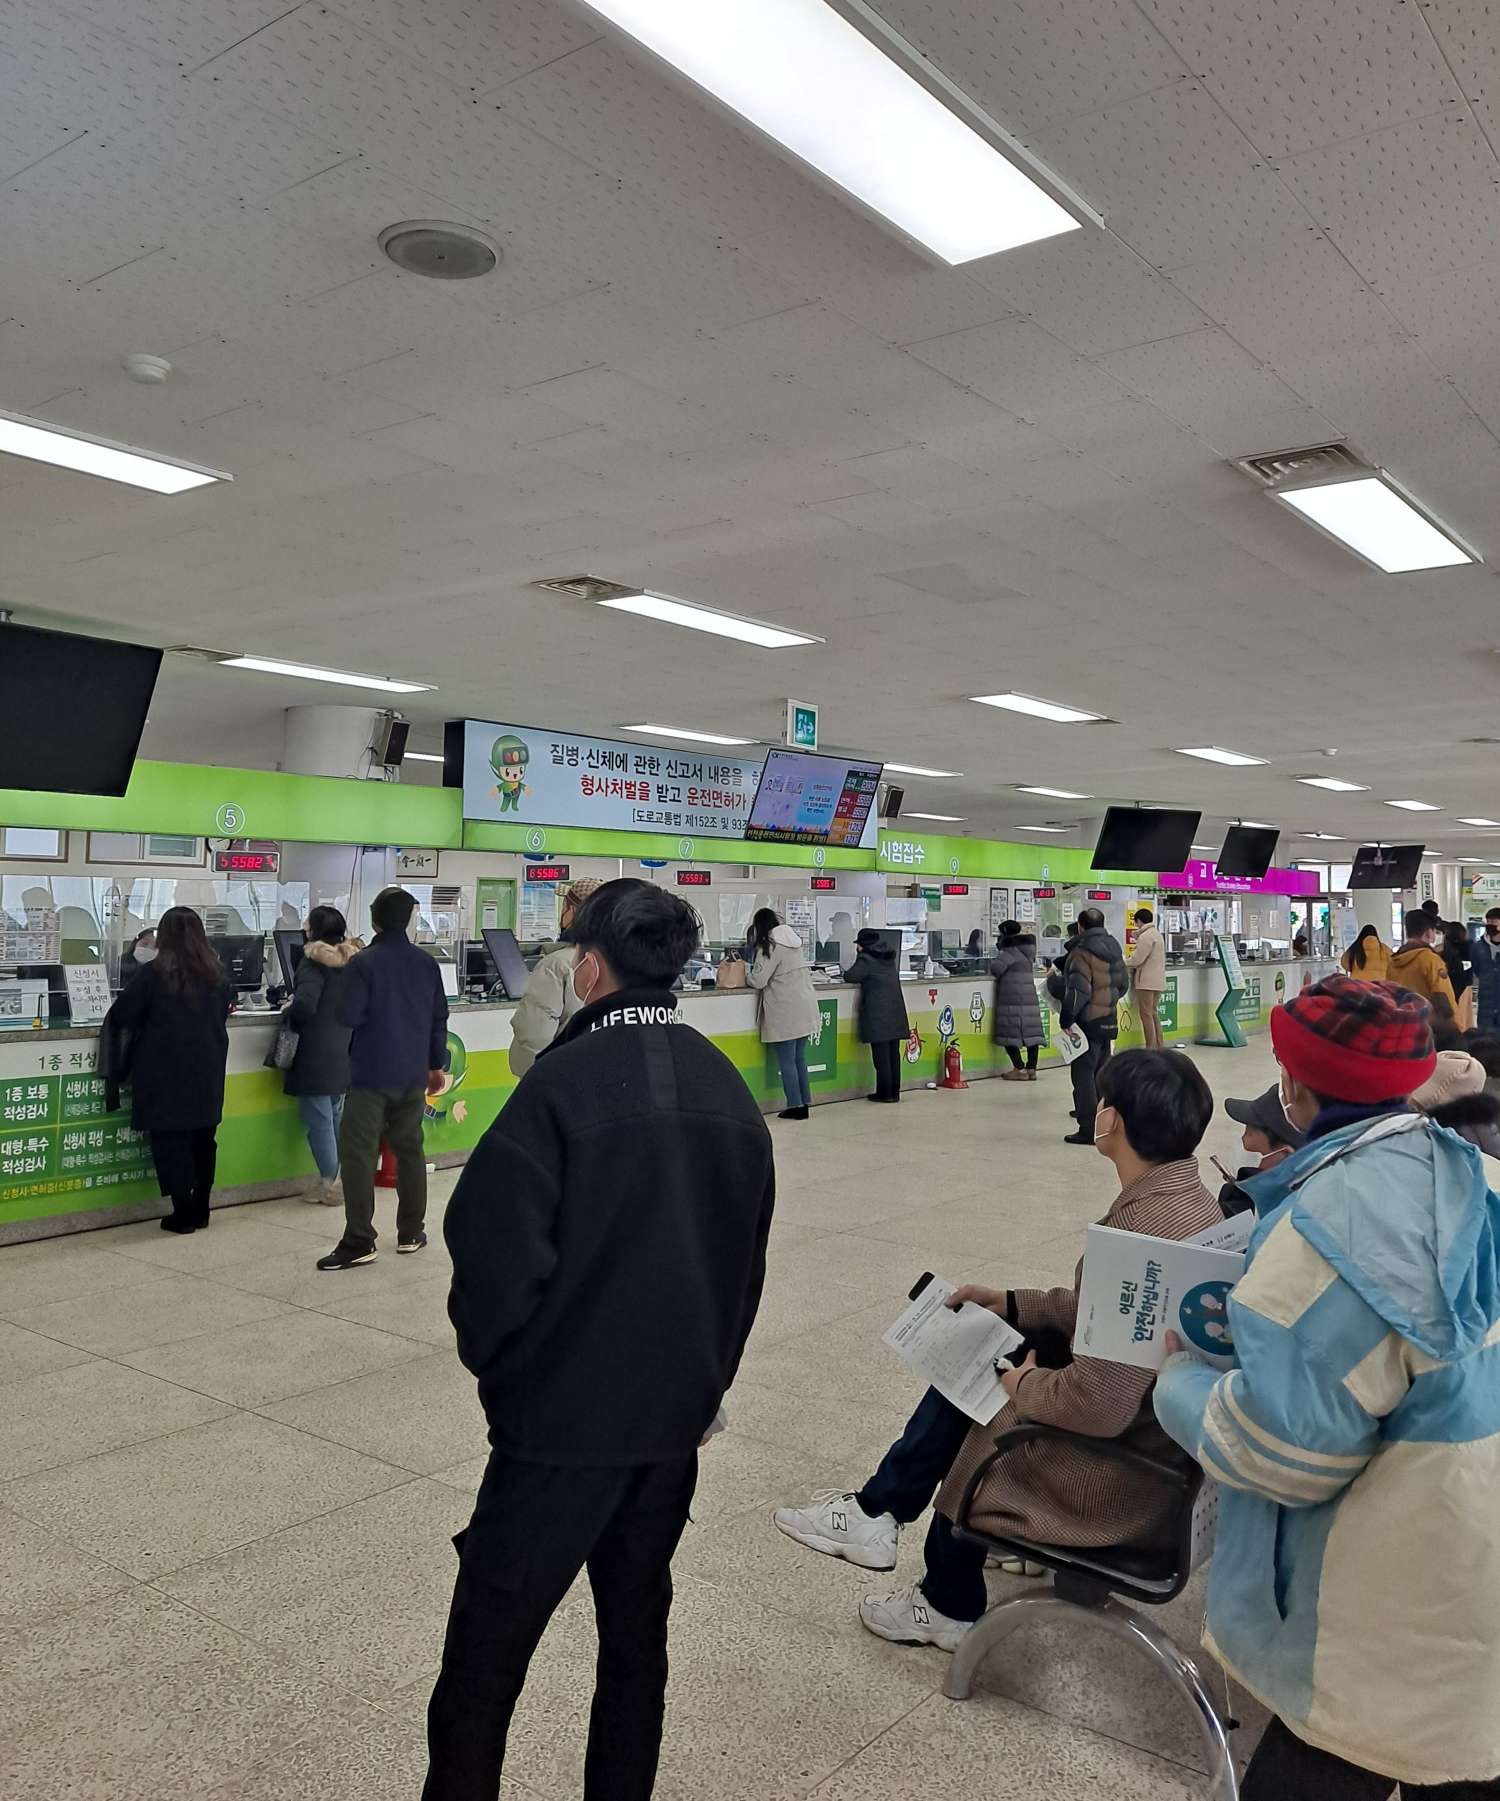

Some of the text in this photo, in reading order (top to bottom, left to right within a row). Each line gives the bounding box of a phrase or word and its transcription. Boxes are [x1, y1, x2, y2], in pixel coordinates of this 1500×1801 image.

[550, 743, 628, 773] 질병·신체에
[634, 755, 661, 776] 관한
[666, 760, 703, 782] 신고서
[708, 765, 744, 786] 내용을
[580, 774, 650, 801] 형사처벌을
[656, 783, 682, 803] 받고
[687, 788, 747, 811] 운전면허가
[224, 809, 237, 828] 5
[685, 814, 718, 829] 제152조
[720, 818, 729, 831] 및
[532, 831, 540, 846] 6
[683, 841, 690, 856] 7
[879, 840, 925, 865] 시험접수
[231, 856, 263, 869] 5582
[38, 1054, 63, 1071] 1종
[5, 1084, 49, 1102] 1종 보통
[66, 1080, 89, 1099] 신청서
[3, 1103, 48, 1121] 적성검사
[1, 1137, 49, 1156] 대형·특수
[63, 1132, 86, 1150] 신청서
[88, 1129, 104, 1148] 작성
[2, 1156, 47, 1175] 적성검사
[1119, 1280, 1138, 1315] 어르신
